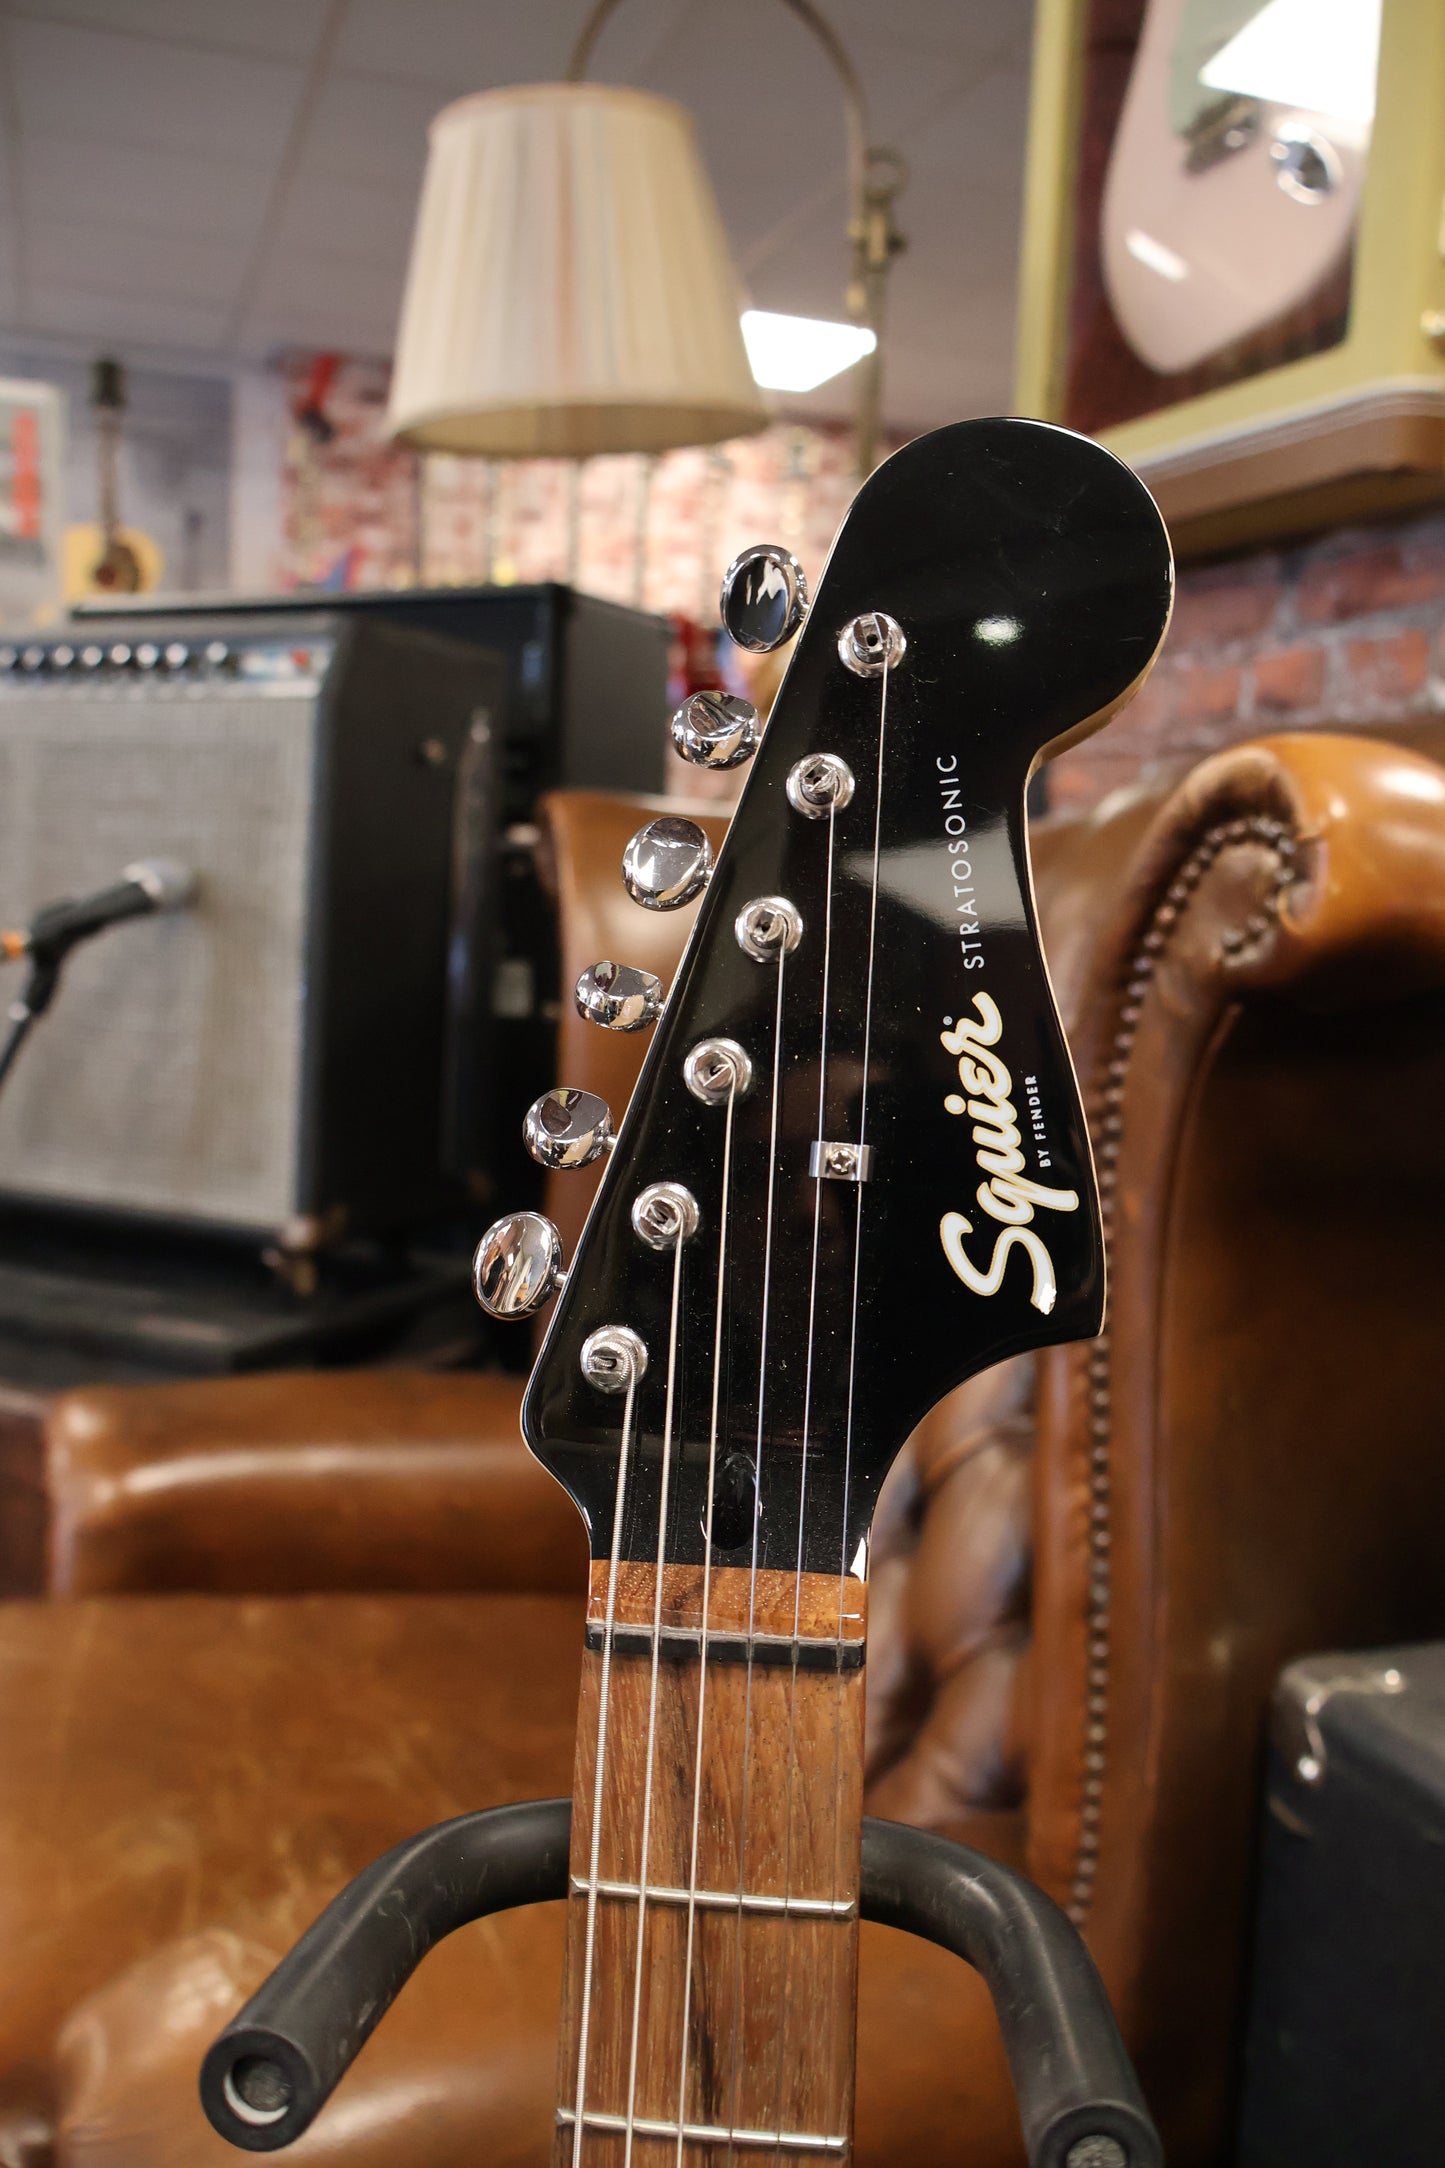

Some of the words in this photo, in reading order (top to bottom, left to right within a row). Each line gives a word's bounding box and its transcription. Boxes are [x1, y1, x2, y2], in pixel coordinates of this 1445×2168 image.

[936, 754, 985, 970] STRATOSONIC
[1025, 1075, 1046, 1141] FENDER
[1037, 1149, 1052, 1168] BY
